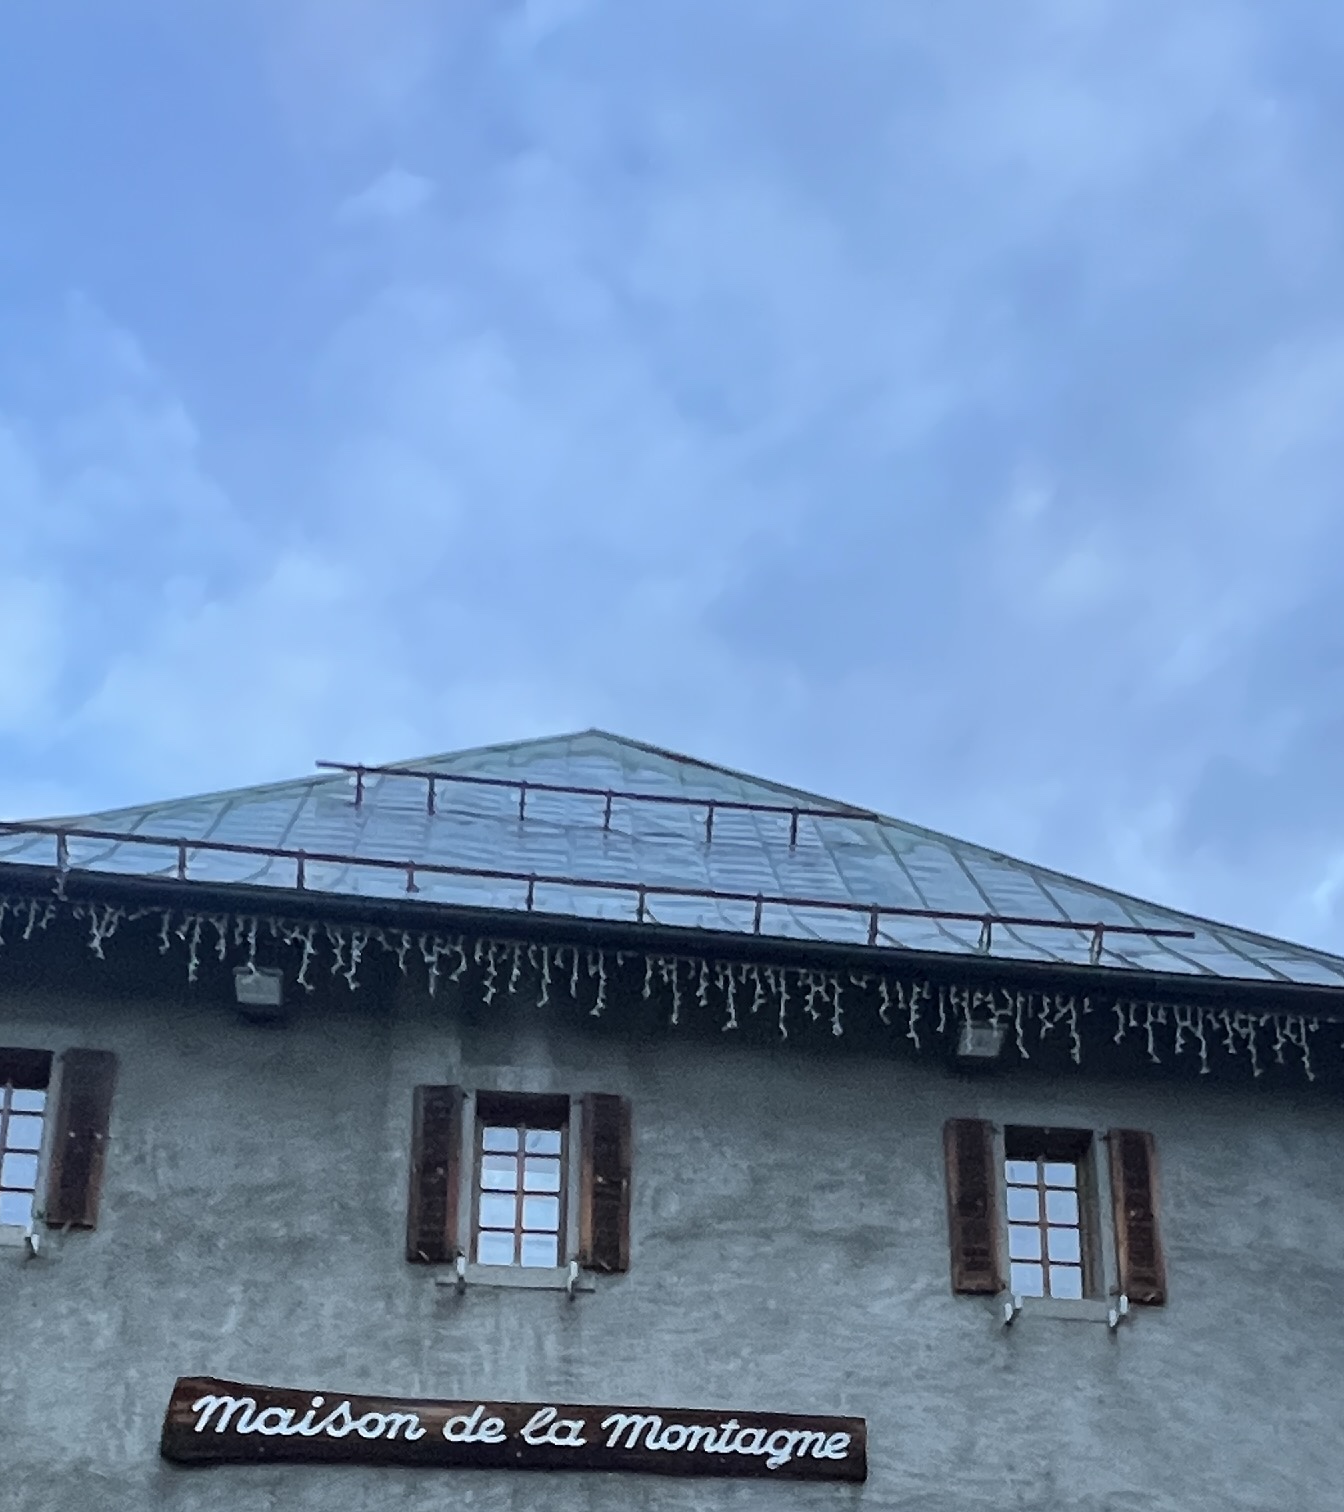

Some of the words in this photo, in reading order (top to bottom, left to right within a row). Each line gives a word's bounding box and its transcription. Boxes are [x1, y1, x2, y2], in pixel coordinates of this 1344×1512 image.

[192, 1395, 427, 1441] Maison
[443, 1404, 507, 1446] de
[521, 1406, 586, 1448] la
[601, 1412, 850, 1471] Montagne
